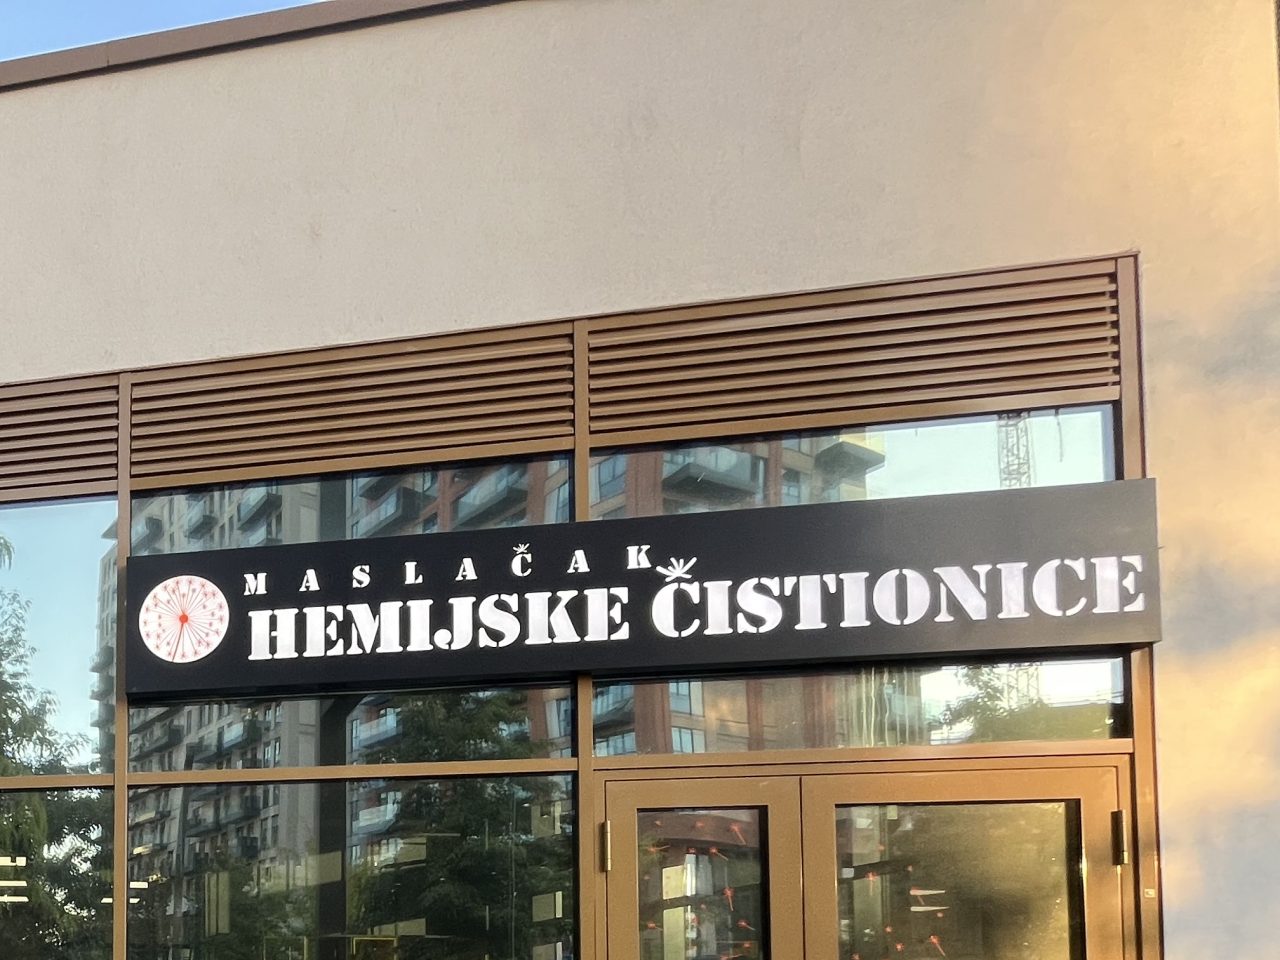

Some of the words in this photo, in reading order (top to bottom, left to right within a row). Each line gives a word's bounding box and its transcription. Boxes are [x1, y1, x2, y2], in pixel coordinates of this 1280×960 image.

[243, 543, 652, 596] MASLAČAK
[247, 586, 630, 661] HEMIJSKE
[651, 555, 1145, 638] ČISTIONICE
